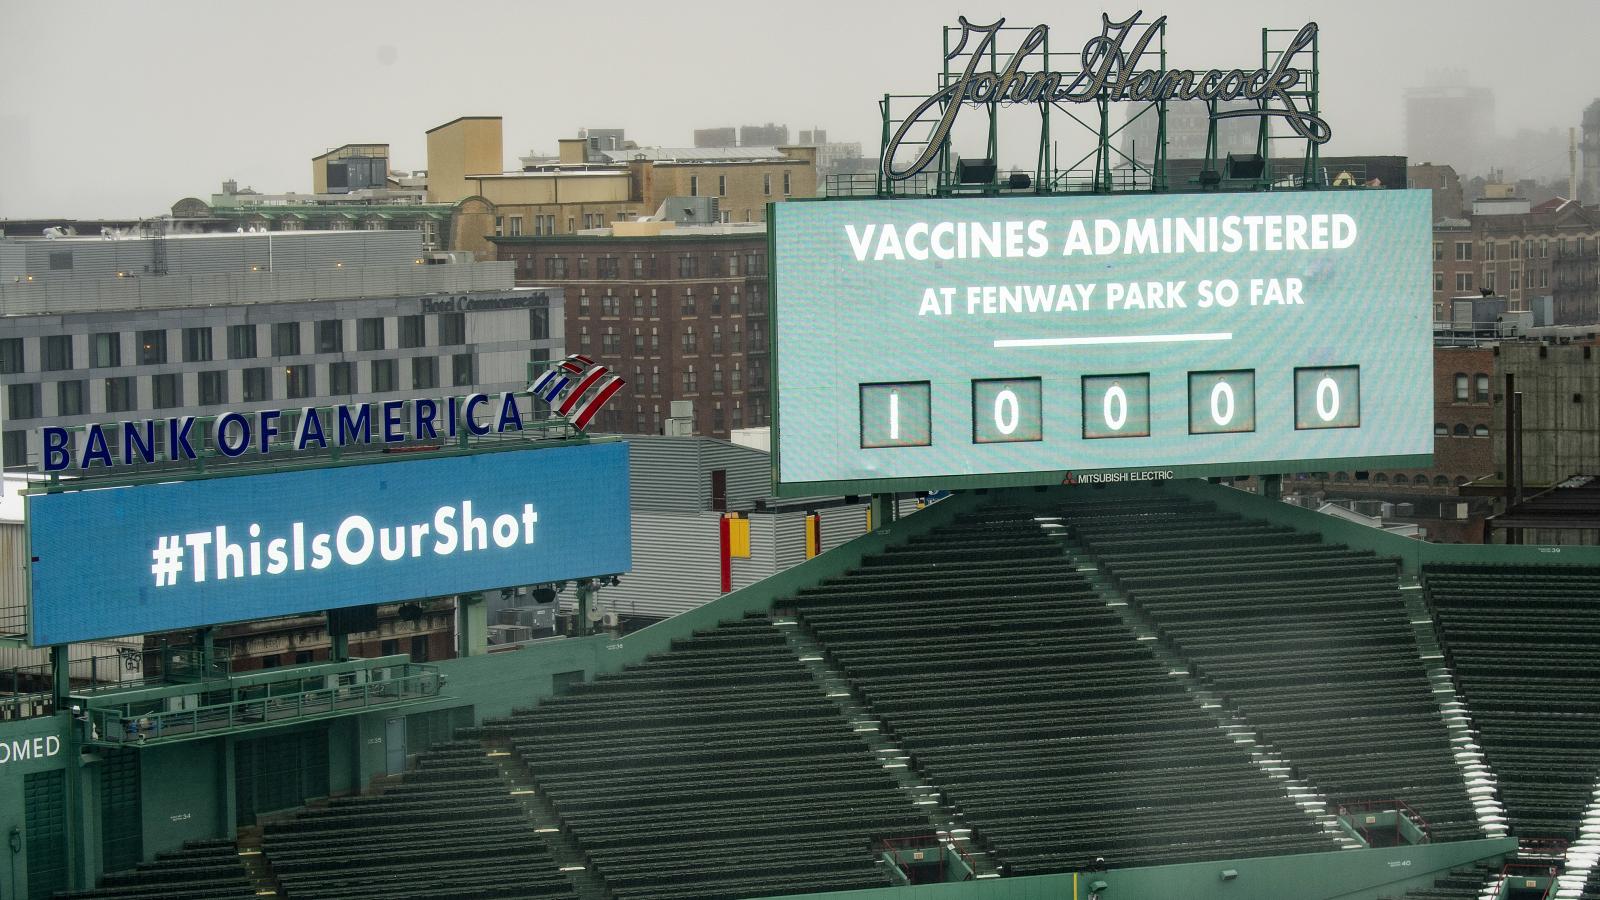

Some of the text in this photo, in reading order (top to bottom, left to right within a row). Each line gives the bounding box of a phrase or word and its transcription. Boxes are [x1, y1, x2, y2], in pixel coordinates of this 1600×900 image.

[883, 10, 1332, 182] John Hancock
[844, 212, 1358, 262] VACCINES ADMINISTERED
[918, 277, 1305, 317] AT FENWAY PARK SO FAR
[42, 391, 524, 471] BANK OF AMERICA
[1077, 470, 1174, 485] MITSUBISHI ELECTRIC
[151, 499, 538, 587] #ThisIsOurShot
